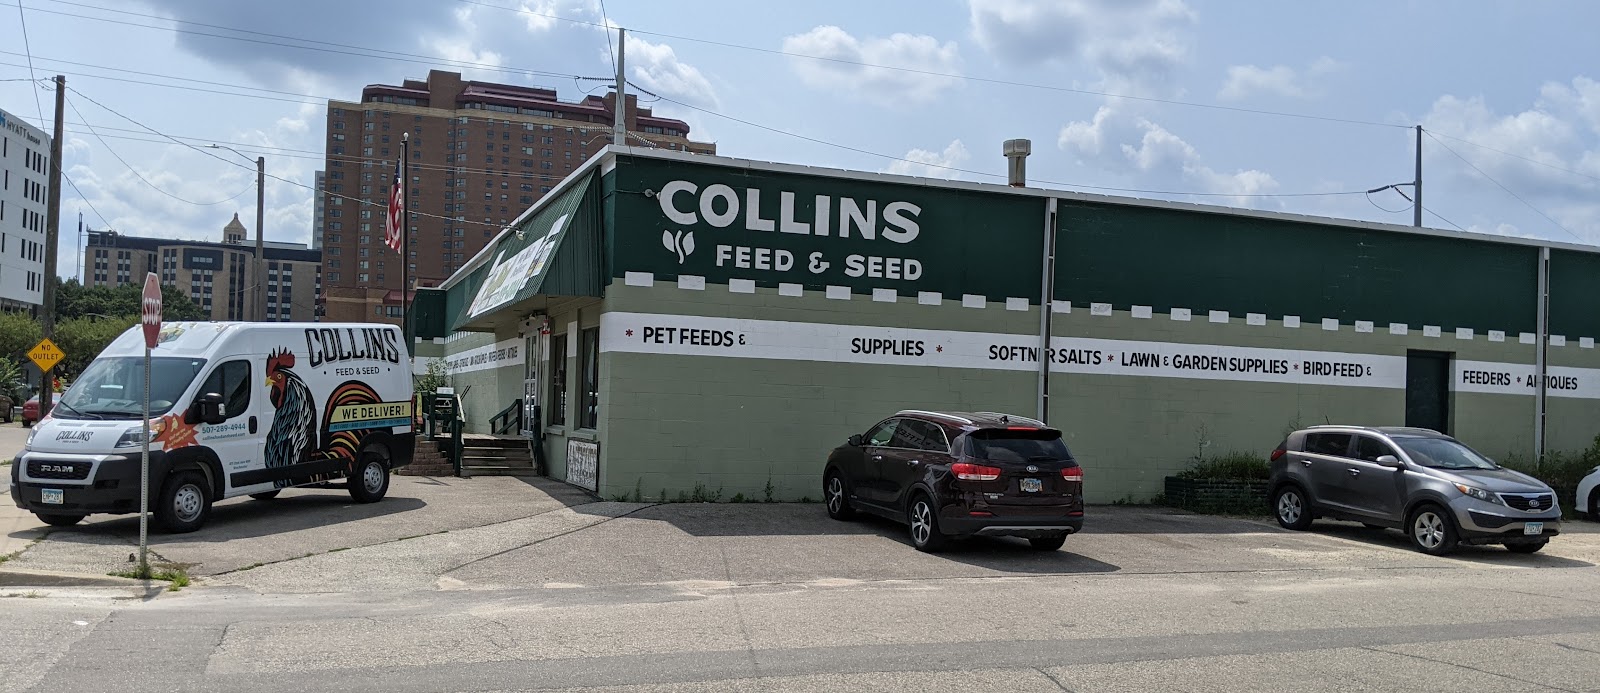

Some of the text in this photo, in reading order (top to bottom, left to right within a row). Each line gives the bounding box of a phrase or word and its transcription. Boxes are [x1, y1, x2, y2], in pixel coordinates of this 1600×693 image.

[6, 120, 27, 138] HYATT
[660, 180, 922, 244] COLLINS
[716, 244, 922, 280] FEED & SEED
[143, 298, 160, 326] STOP
[642, 326, 677, 344] PET
[680, 328, 734, 347] FEEDS
[305, 328, 399, 368] COLLINS
[850, 338, 925, 356] SUPPLIES
[988, 344, 1102, 365] SOFTNR SALTS
[336, 366, 380, 376] FEED & SEED
[1121, 352, 1160, 368] LAWN
[1172, 354, 1227, 372] GARDEN
[1228, 357, 1288, 374] SUPPLIES
[1303, 361, 1332, 376] BIRD
[1333, 362, 1364, 378] FEED
[1462, 370, 1510, 386] FEEDERS
[1526, 374, 1578, 390] AIQUES
[342, 405, 404, 420] WE DELIVER!
[56, 430, 94, 442] COLLINS
[202, 423, 246, 434] 507-289-4944
[40, 464, 74, 473] RAM
